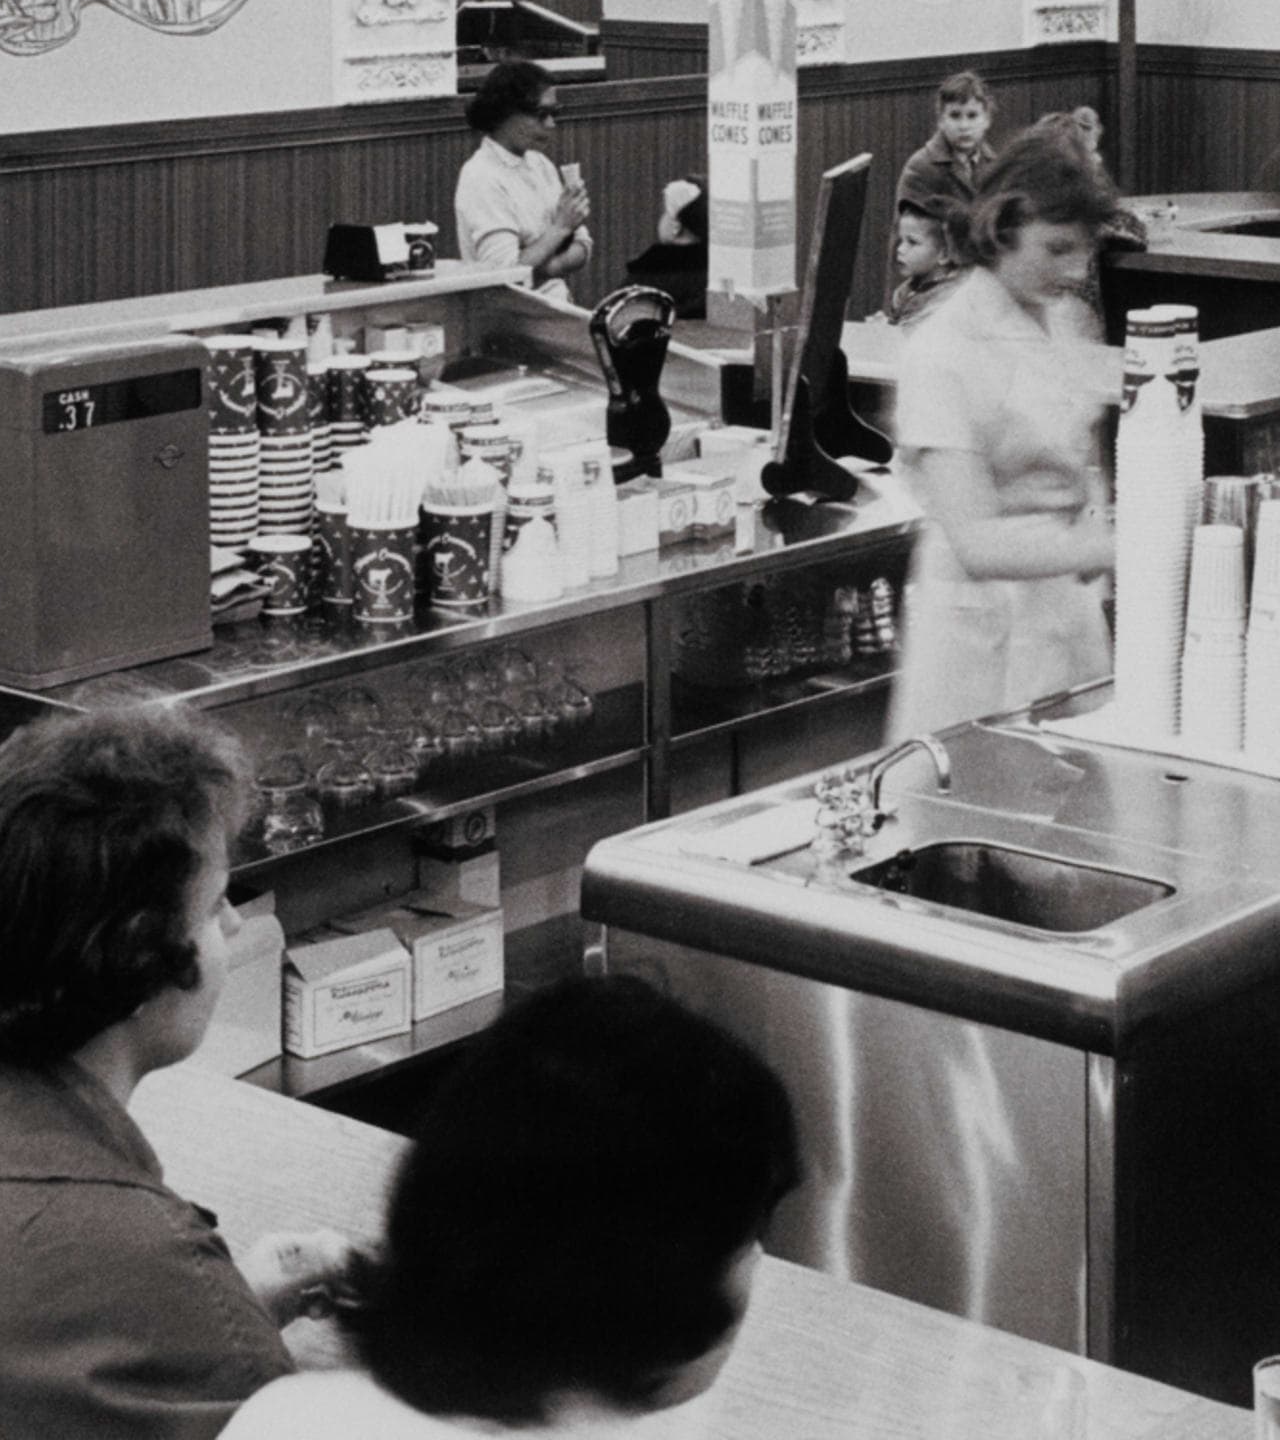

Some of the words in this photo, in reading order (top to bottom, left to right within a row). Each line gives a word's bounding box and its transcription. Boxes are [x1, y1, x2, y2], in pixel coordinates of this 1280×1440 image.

[711, 101, 749, 121] WAFFLE
[757, 101, 793, 121] WAFFLE
[711, 124, 748, 145] CONES
[758, 124, 793, 145] CONES
[59, 390, 90, 405] CASH
